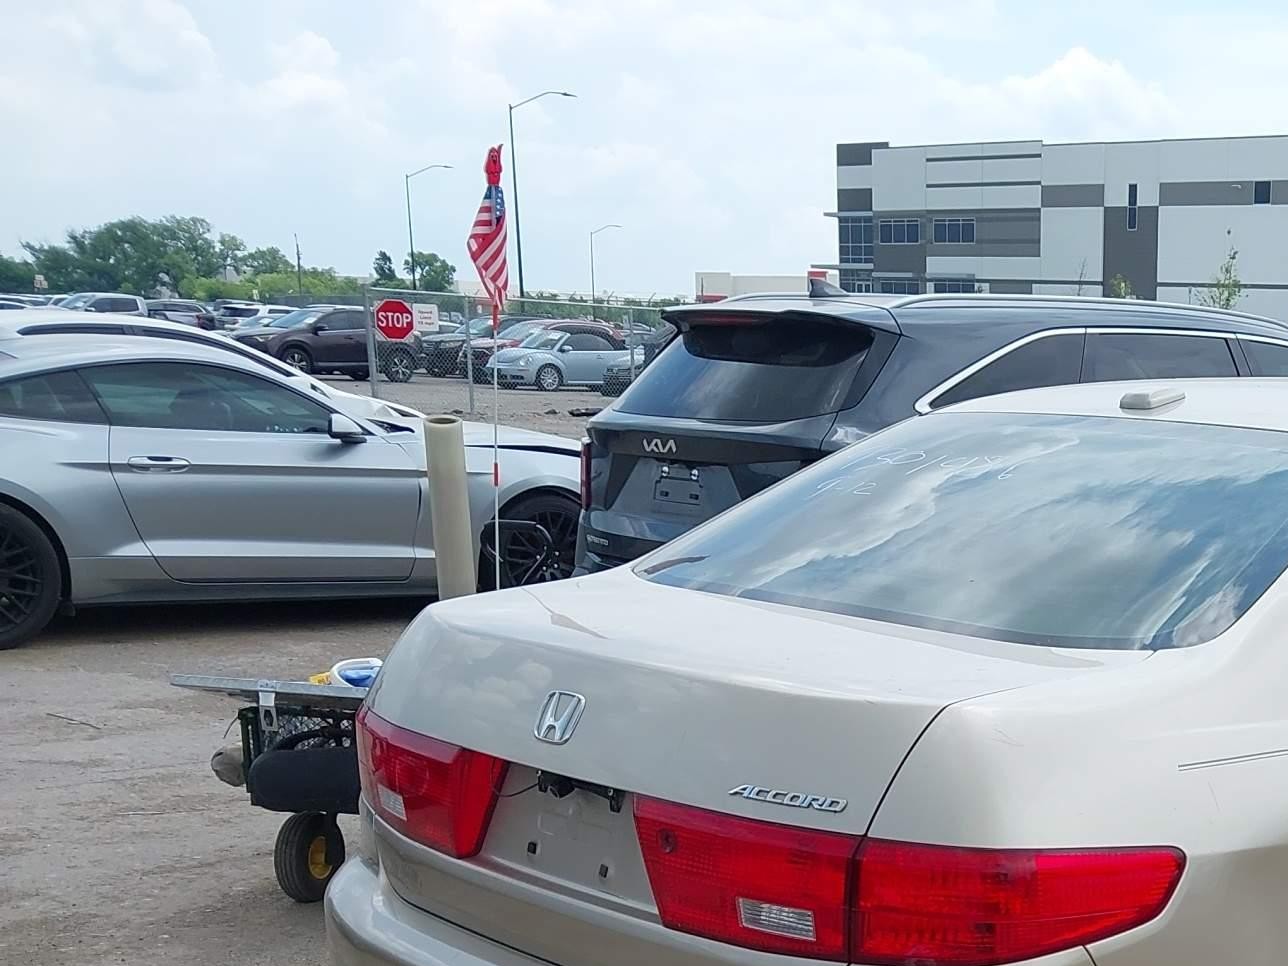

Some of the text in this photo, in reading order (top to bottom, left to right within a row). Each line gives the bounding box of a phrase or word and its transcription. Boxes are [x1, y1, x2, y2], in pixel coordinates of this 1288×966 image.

[378, 311, 412, 328] STOP
[642, 438, 677, 453] KIA
[727, 784, 849, 813] ACCORD
